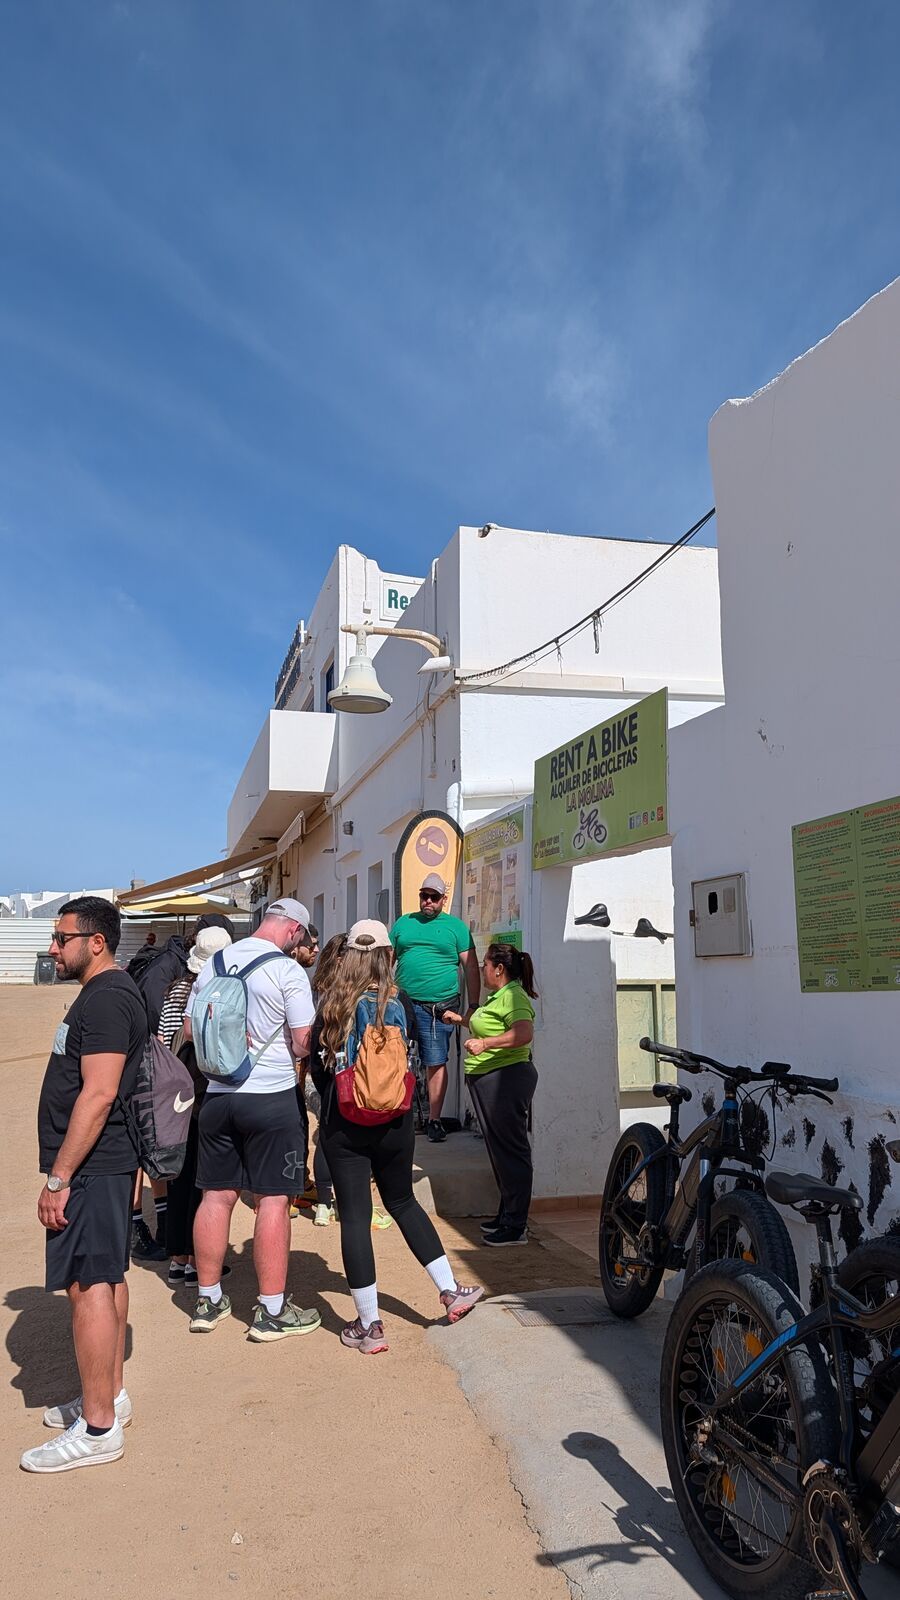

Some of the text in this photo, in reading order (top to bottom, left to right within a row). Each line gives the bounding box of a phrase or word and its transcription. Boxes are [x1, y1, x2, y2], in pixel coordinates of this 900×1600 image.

[550, 711, 639, 783] RENT A BIKE
[550, 746, 638, 800] ALQUILER DE BICICLETAS
[566, 777, 615, 813] LA MOLINA
